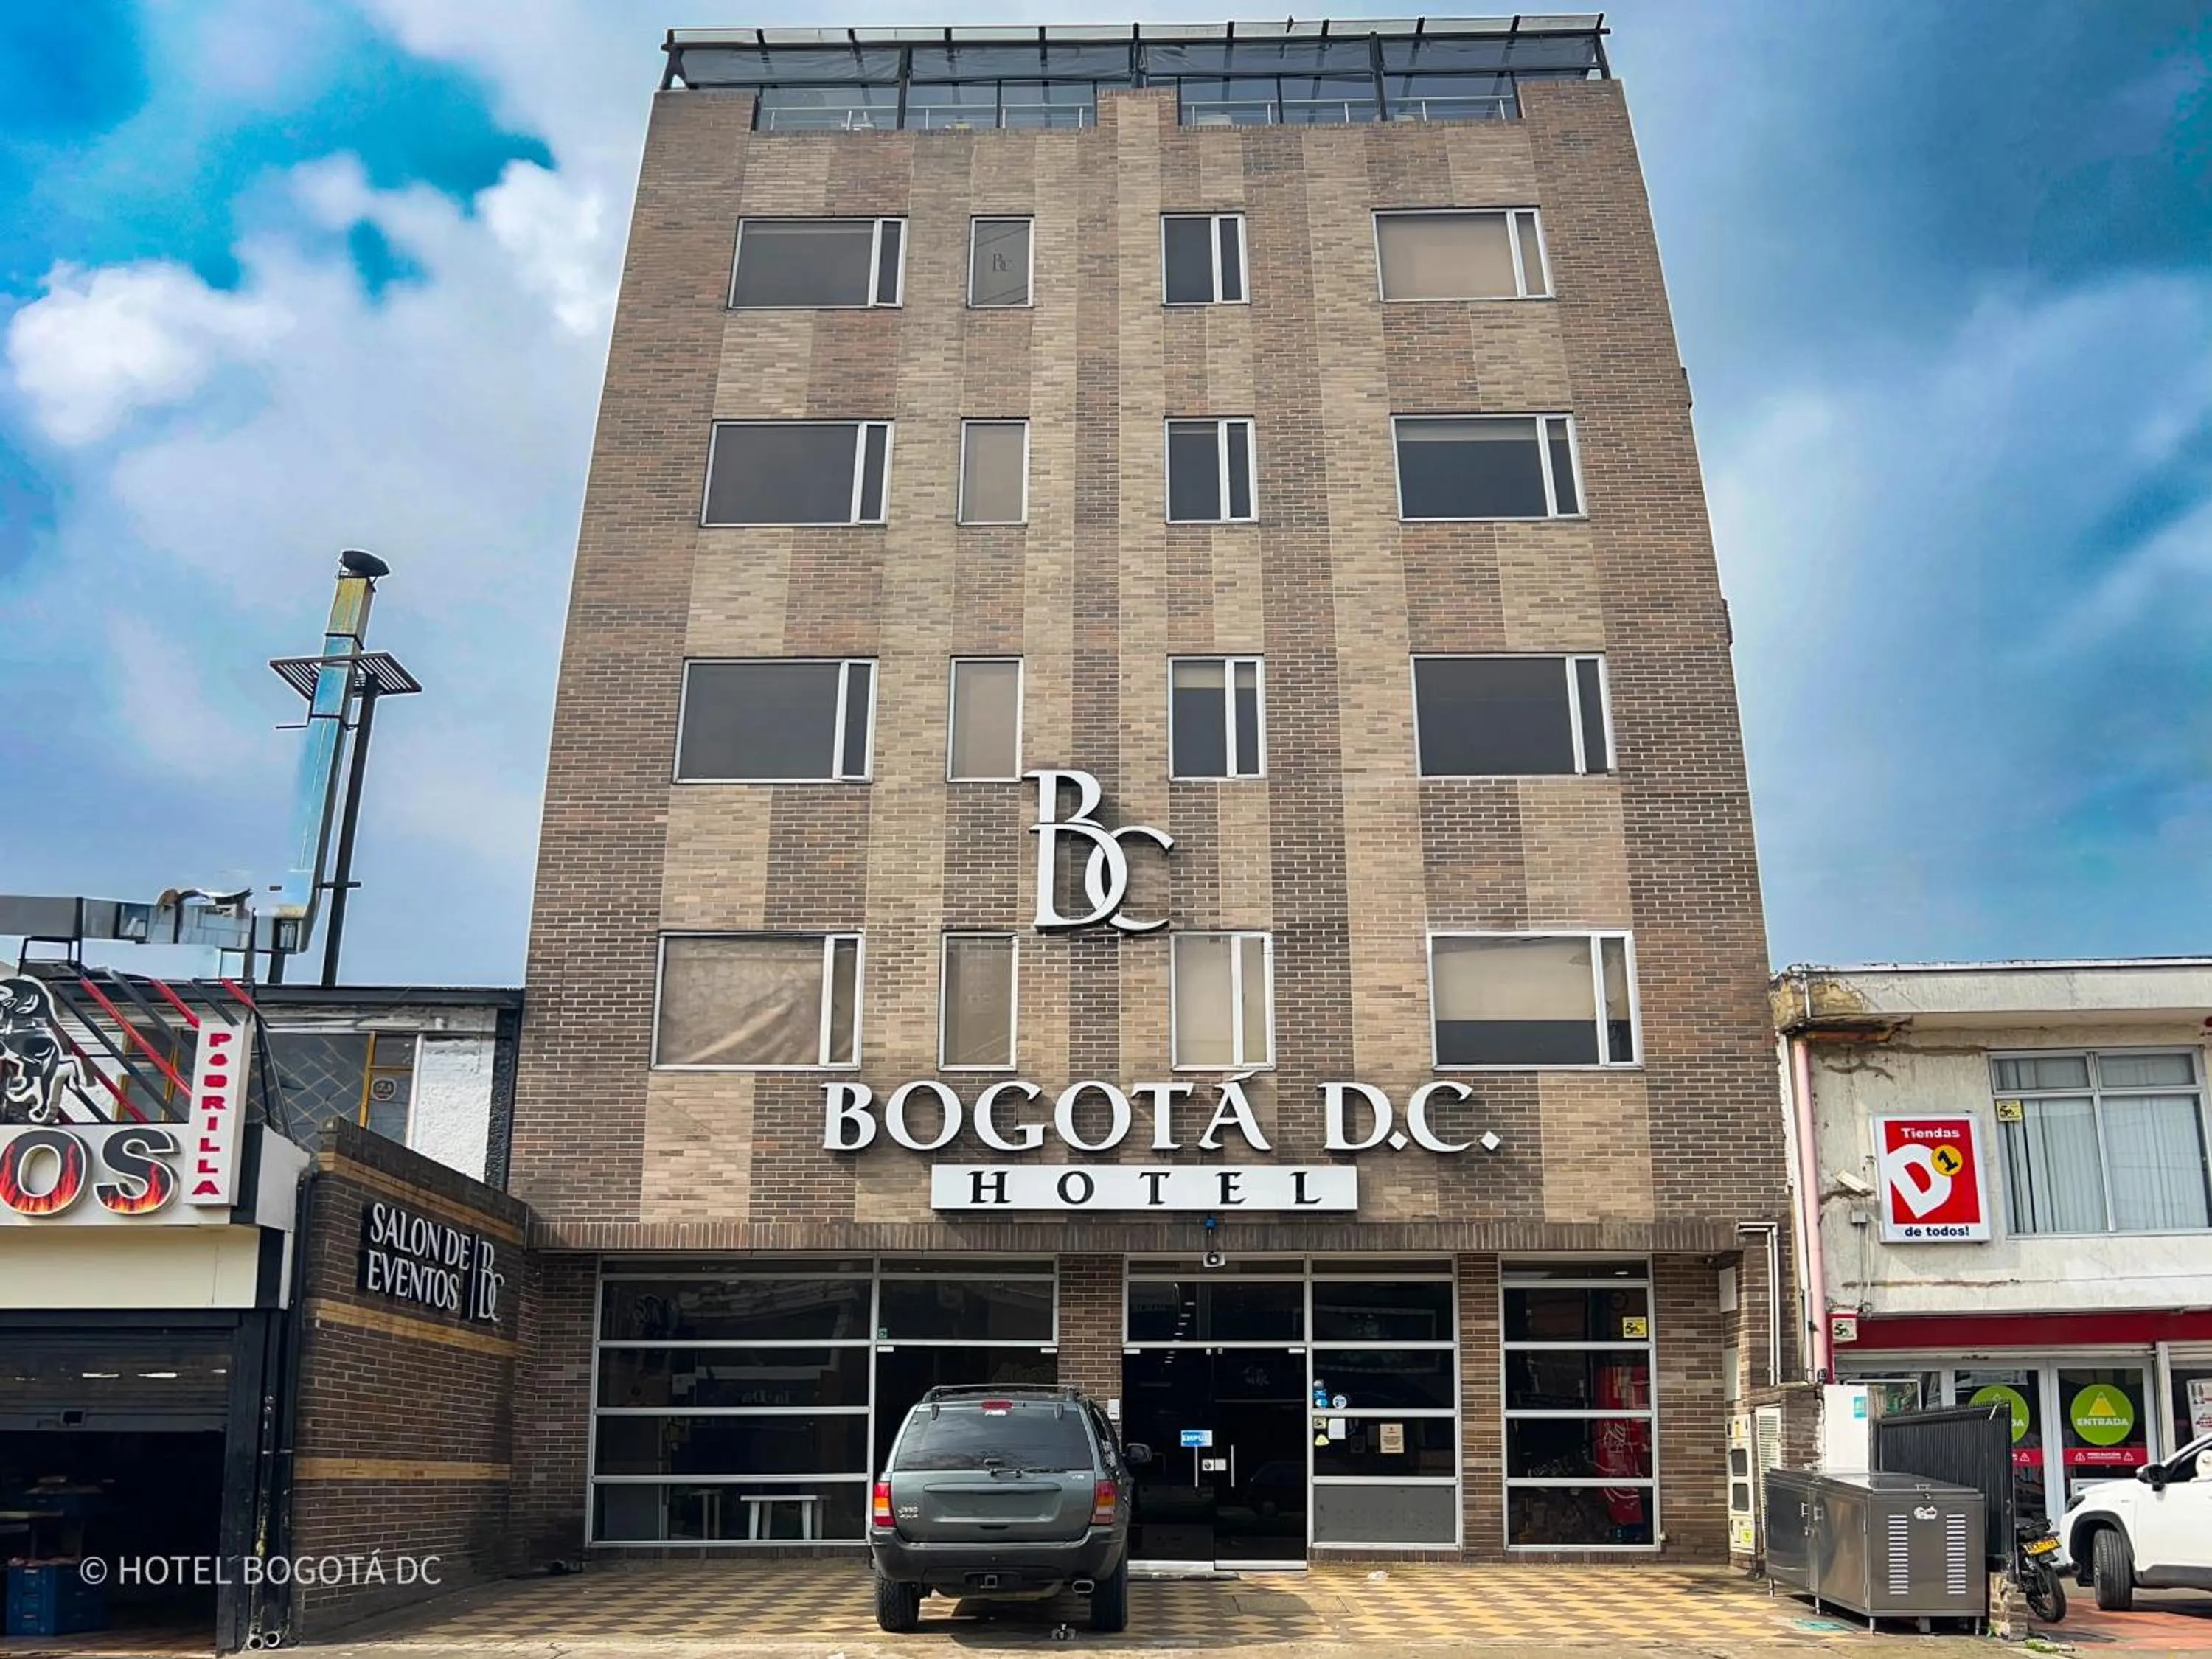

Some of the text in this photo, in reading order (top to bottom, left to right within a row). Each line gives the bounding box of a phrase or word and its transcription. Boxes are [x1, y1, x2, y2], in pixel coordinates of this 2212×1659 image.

[820, 1071, 1500, 1152] BOGOTÁ D.C.
[1901, 1127, 1961, 1139] Tiendas
[967, 1171, 1322, 1206] HOTEL
[370, 1203, 470, 1270] SALON DE
[1905, 1226, 1969, 1237] de todos!
[367, 1250, 459, 1310] EVENTOS
[2076, 1417, 2129, 1427] ENTRADA
